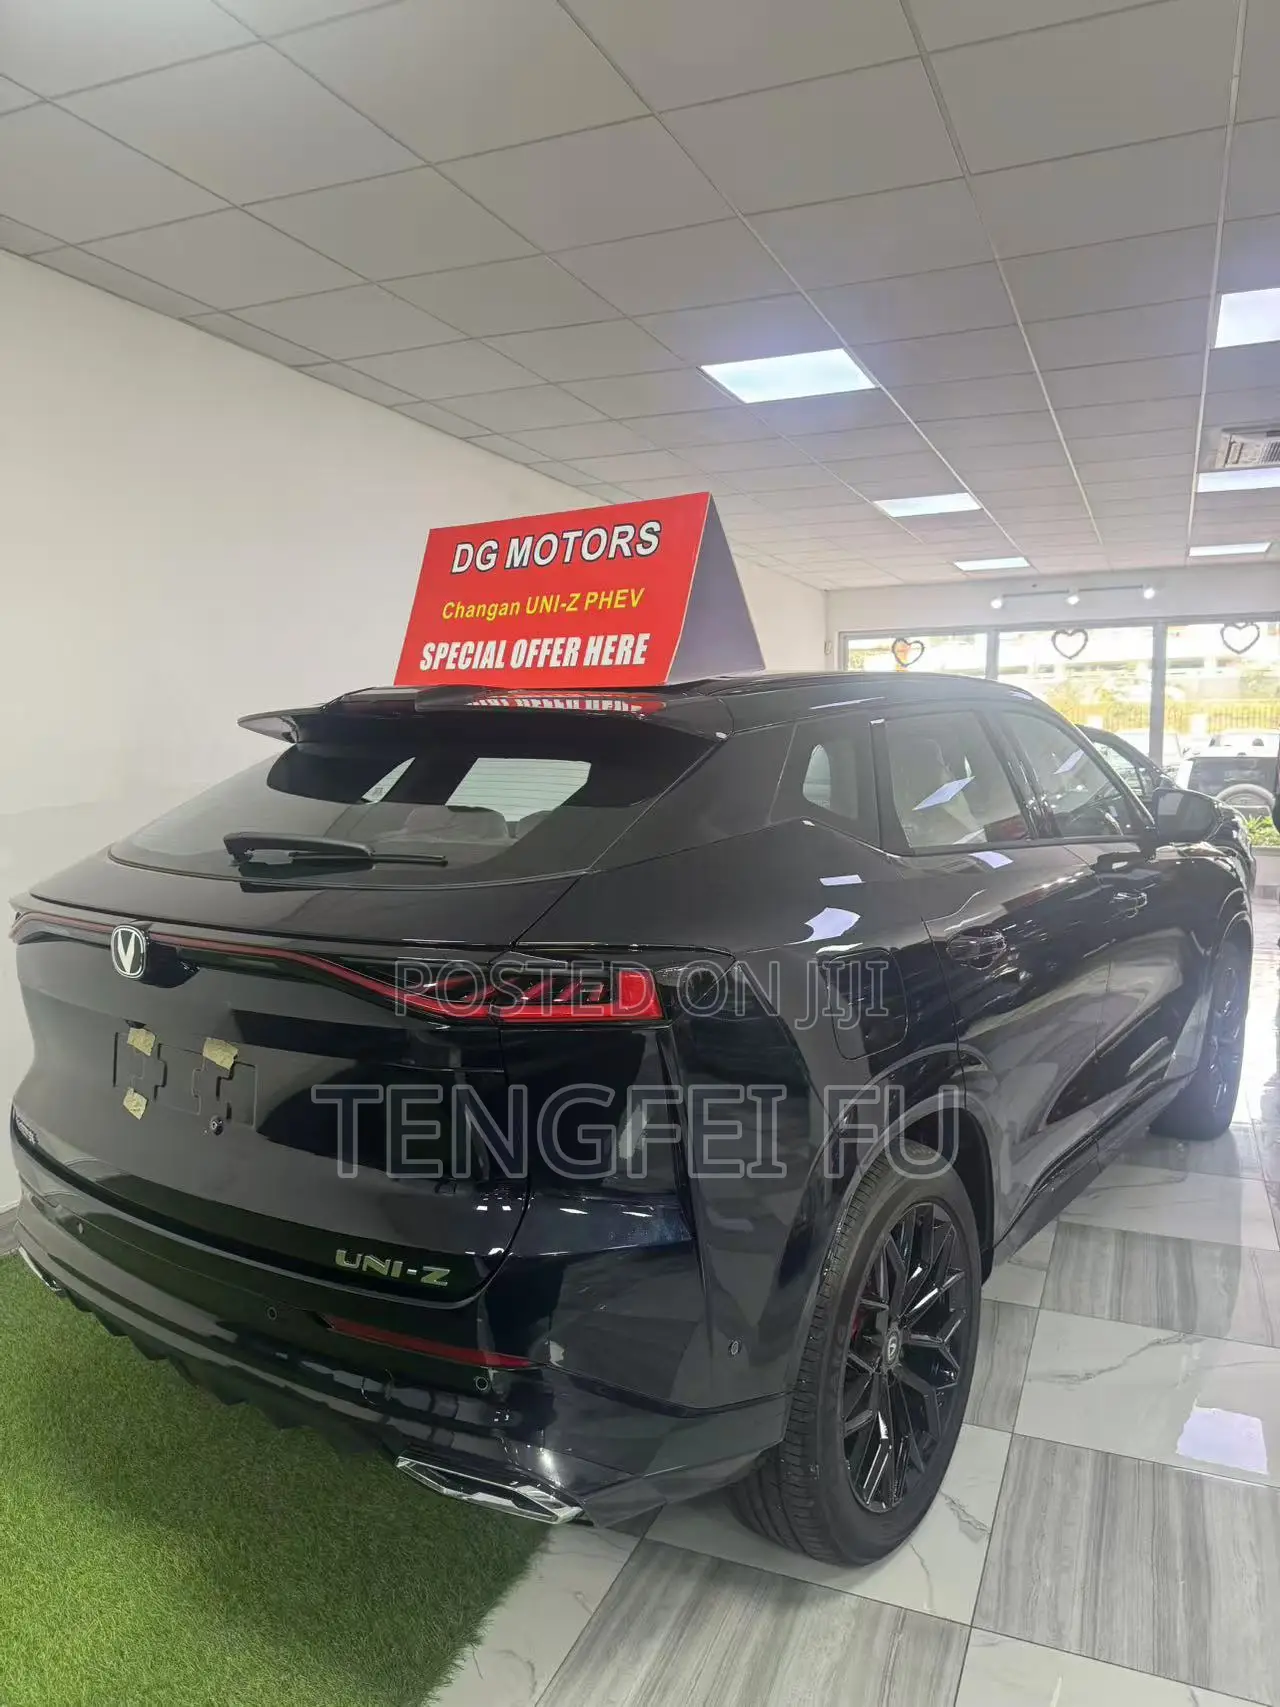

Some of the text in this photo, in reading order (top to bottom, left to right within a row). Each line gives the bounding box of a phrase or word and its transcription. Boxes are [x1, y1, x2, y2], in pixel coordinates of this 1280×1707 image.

[451, 520, 661, 574] DG MOTORS
[442, 588, 645, 622] Changan UNI-Z PHEV
[419, 633, 650, 671] SPECIAL OFFER HERE
[335, 1249, 450, 1286] UNI-Z
